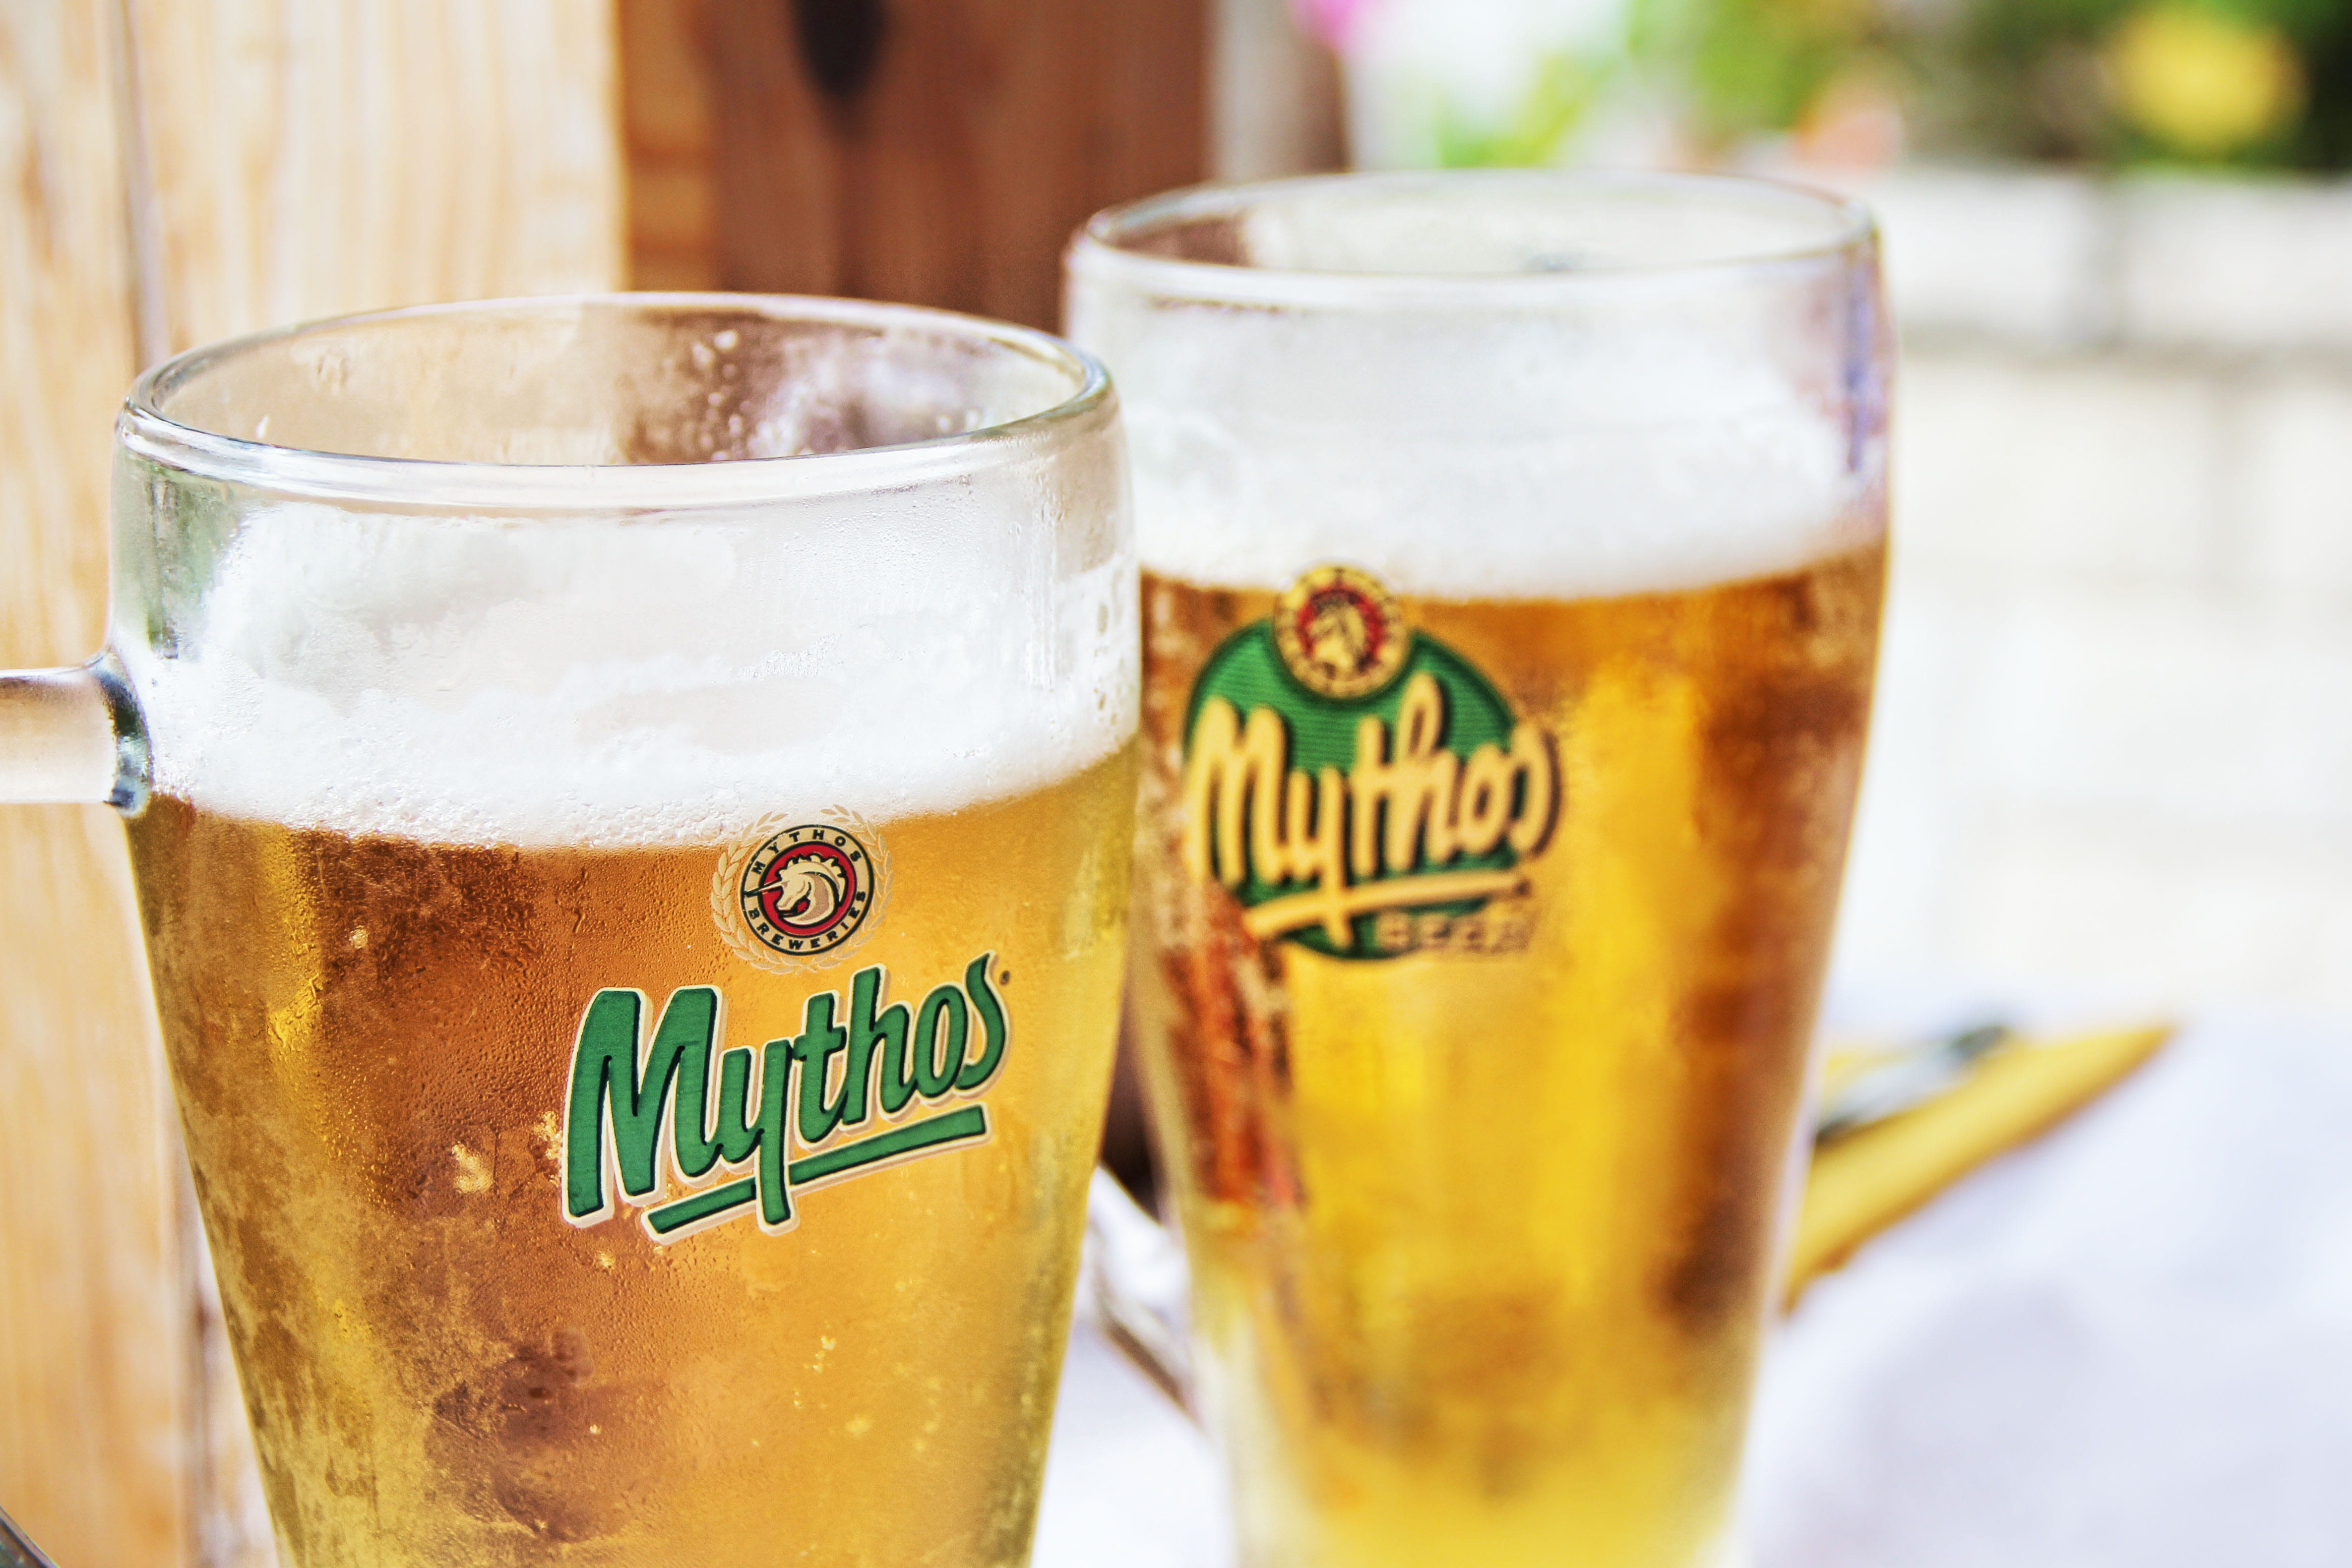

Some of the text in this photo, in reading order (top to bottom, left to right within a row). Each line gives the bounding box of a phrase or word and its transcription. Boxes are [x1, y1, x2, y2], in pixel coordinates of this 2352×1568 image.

[751, 829, 862, 875] MYTHOS
[1188, 670, 1561, 948] Mythos
[748, 891, 866, 951] BREWERIES
[563, 950, 1009, 1235] Mythos
